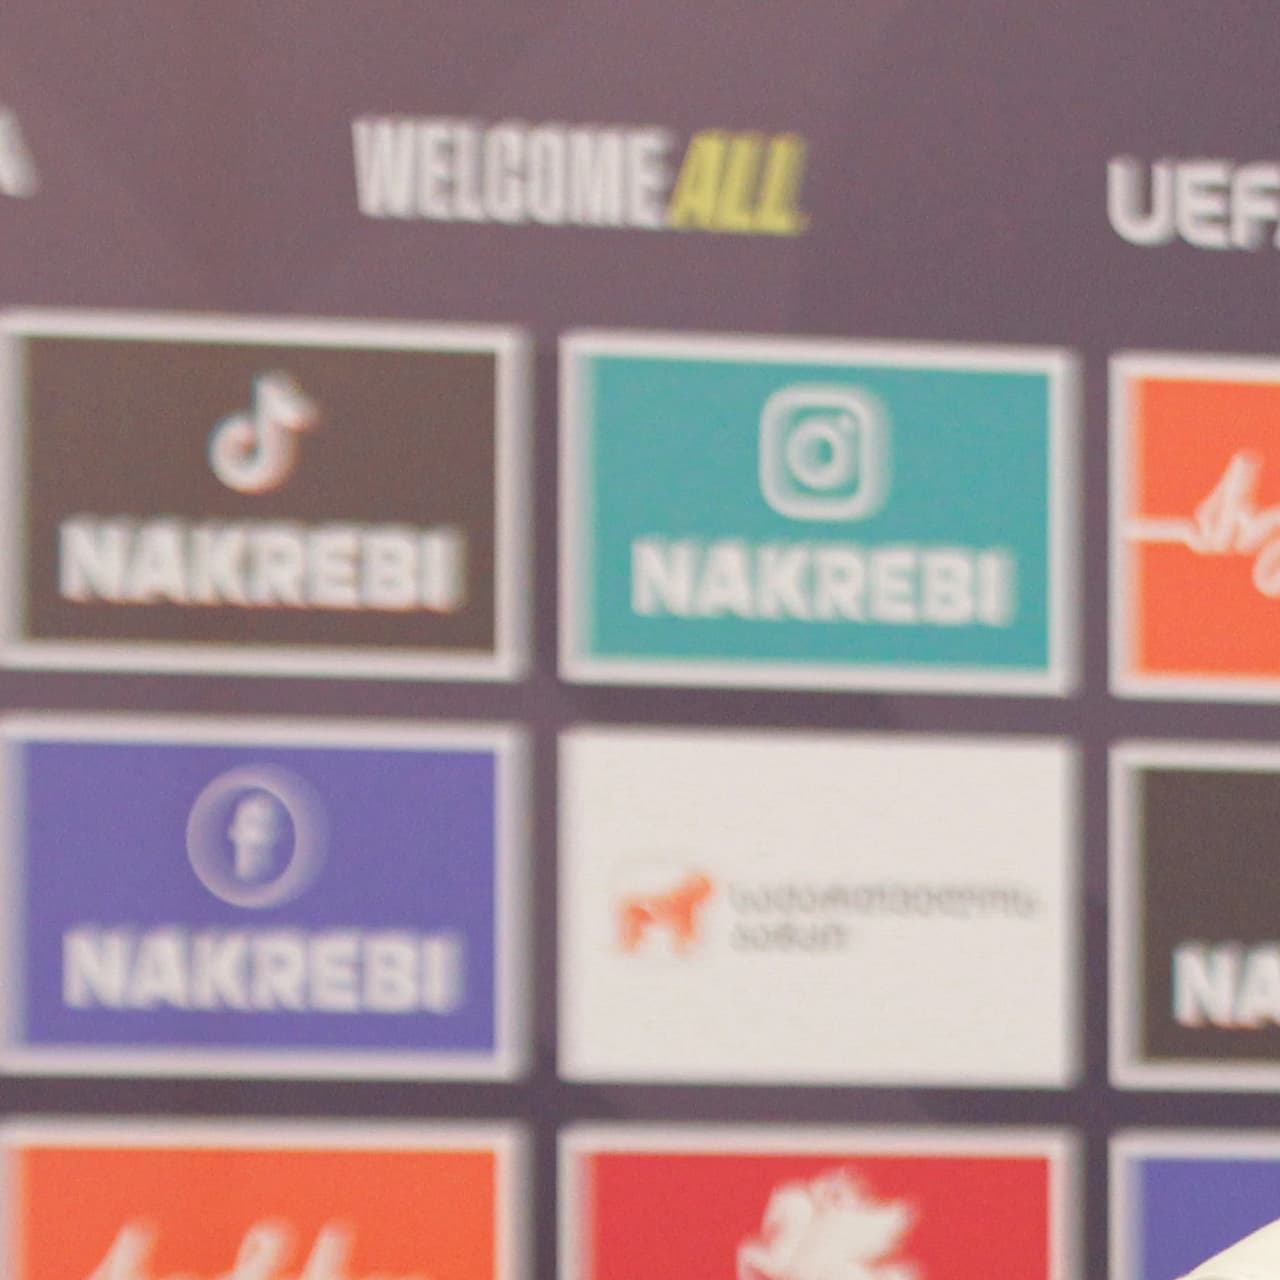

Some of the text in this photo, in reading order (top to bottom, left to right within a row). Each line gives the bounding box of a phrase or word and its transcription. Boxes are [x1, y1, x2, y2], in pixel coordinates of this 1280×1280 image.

[353, 117, 806, 233] WELCOME ALL
[58, 517, 465, 611] NAKREBI
[630, 538, 1013, 626] NAKREBI
[62, 926, 462, 1014] NAKREBI
